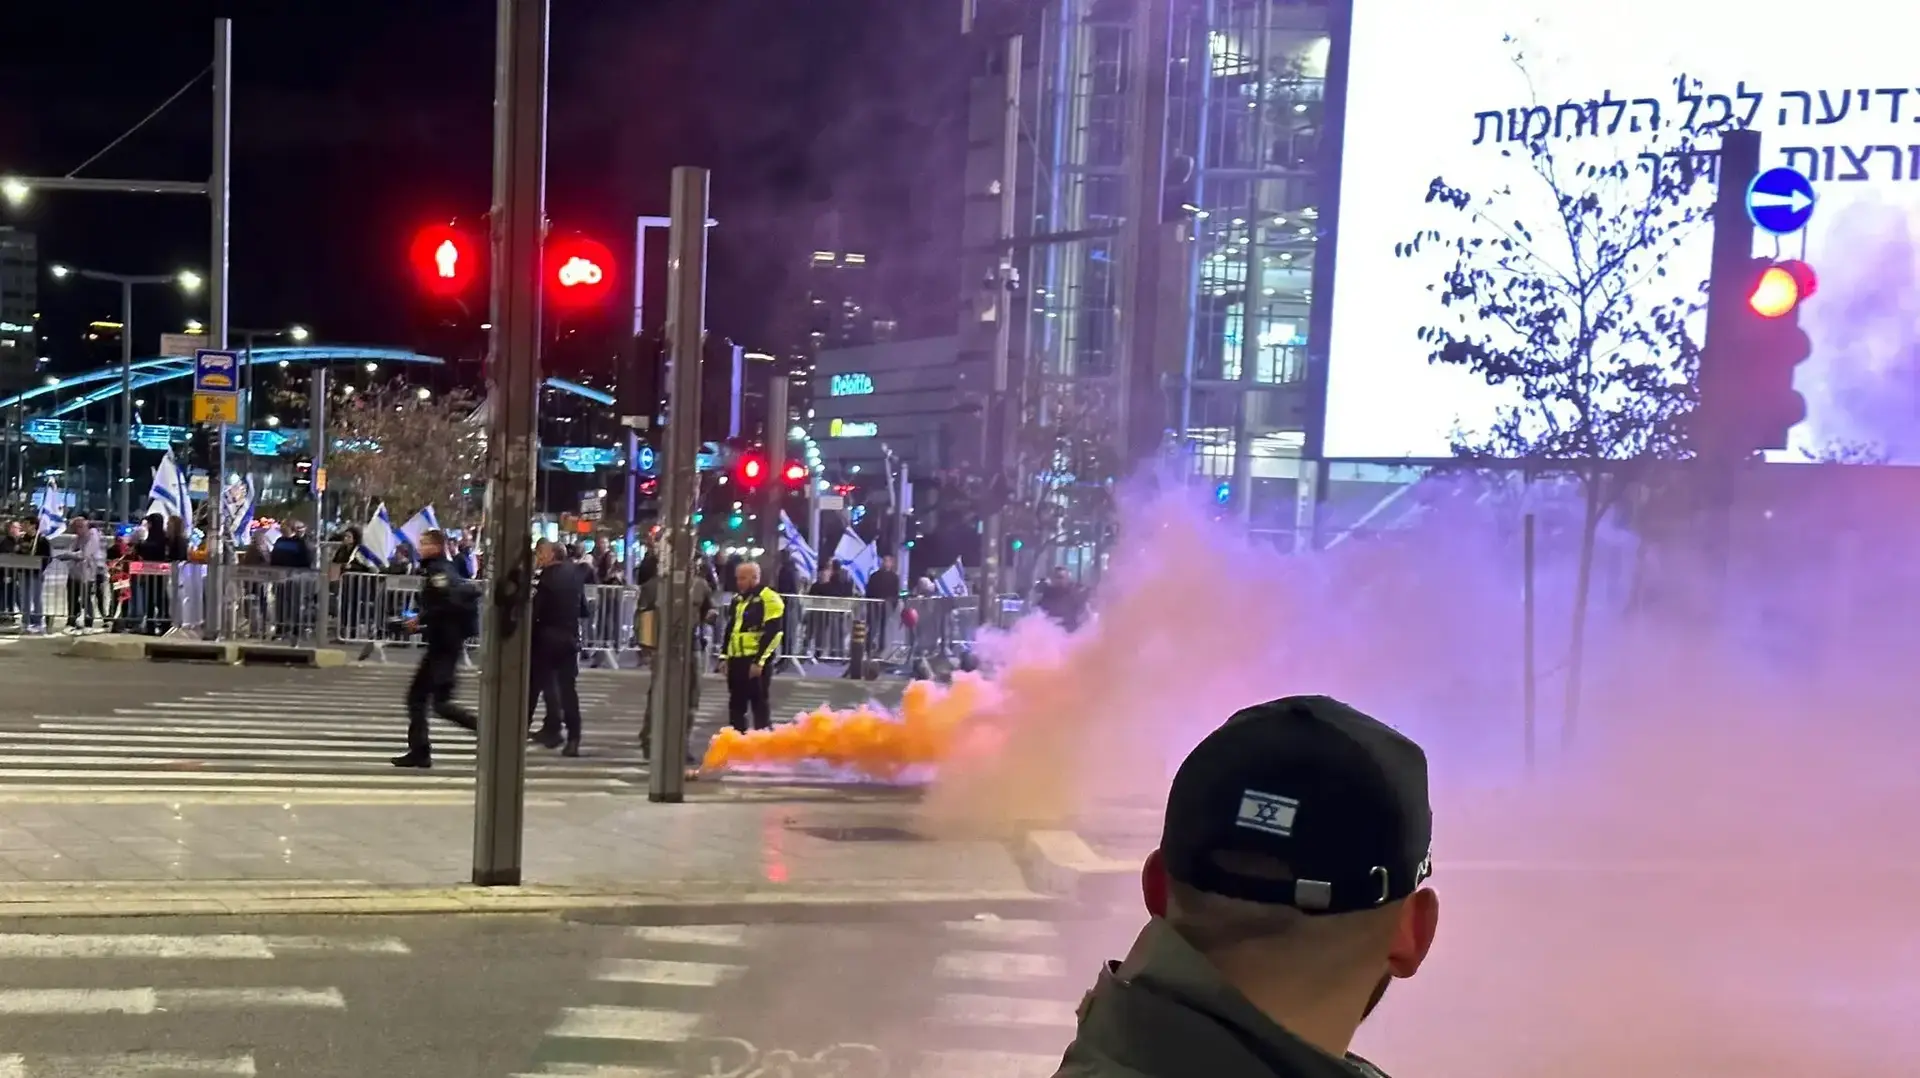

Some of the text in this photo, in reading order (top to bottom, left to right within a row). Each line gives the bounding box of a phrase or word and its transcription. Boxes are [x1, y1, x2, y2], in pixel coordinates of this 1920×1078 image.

[1472, 78, 1920, 145] דיעה לכל הלוחמות
